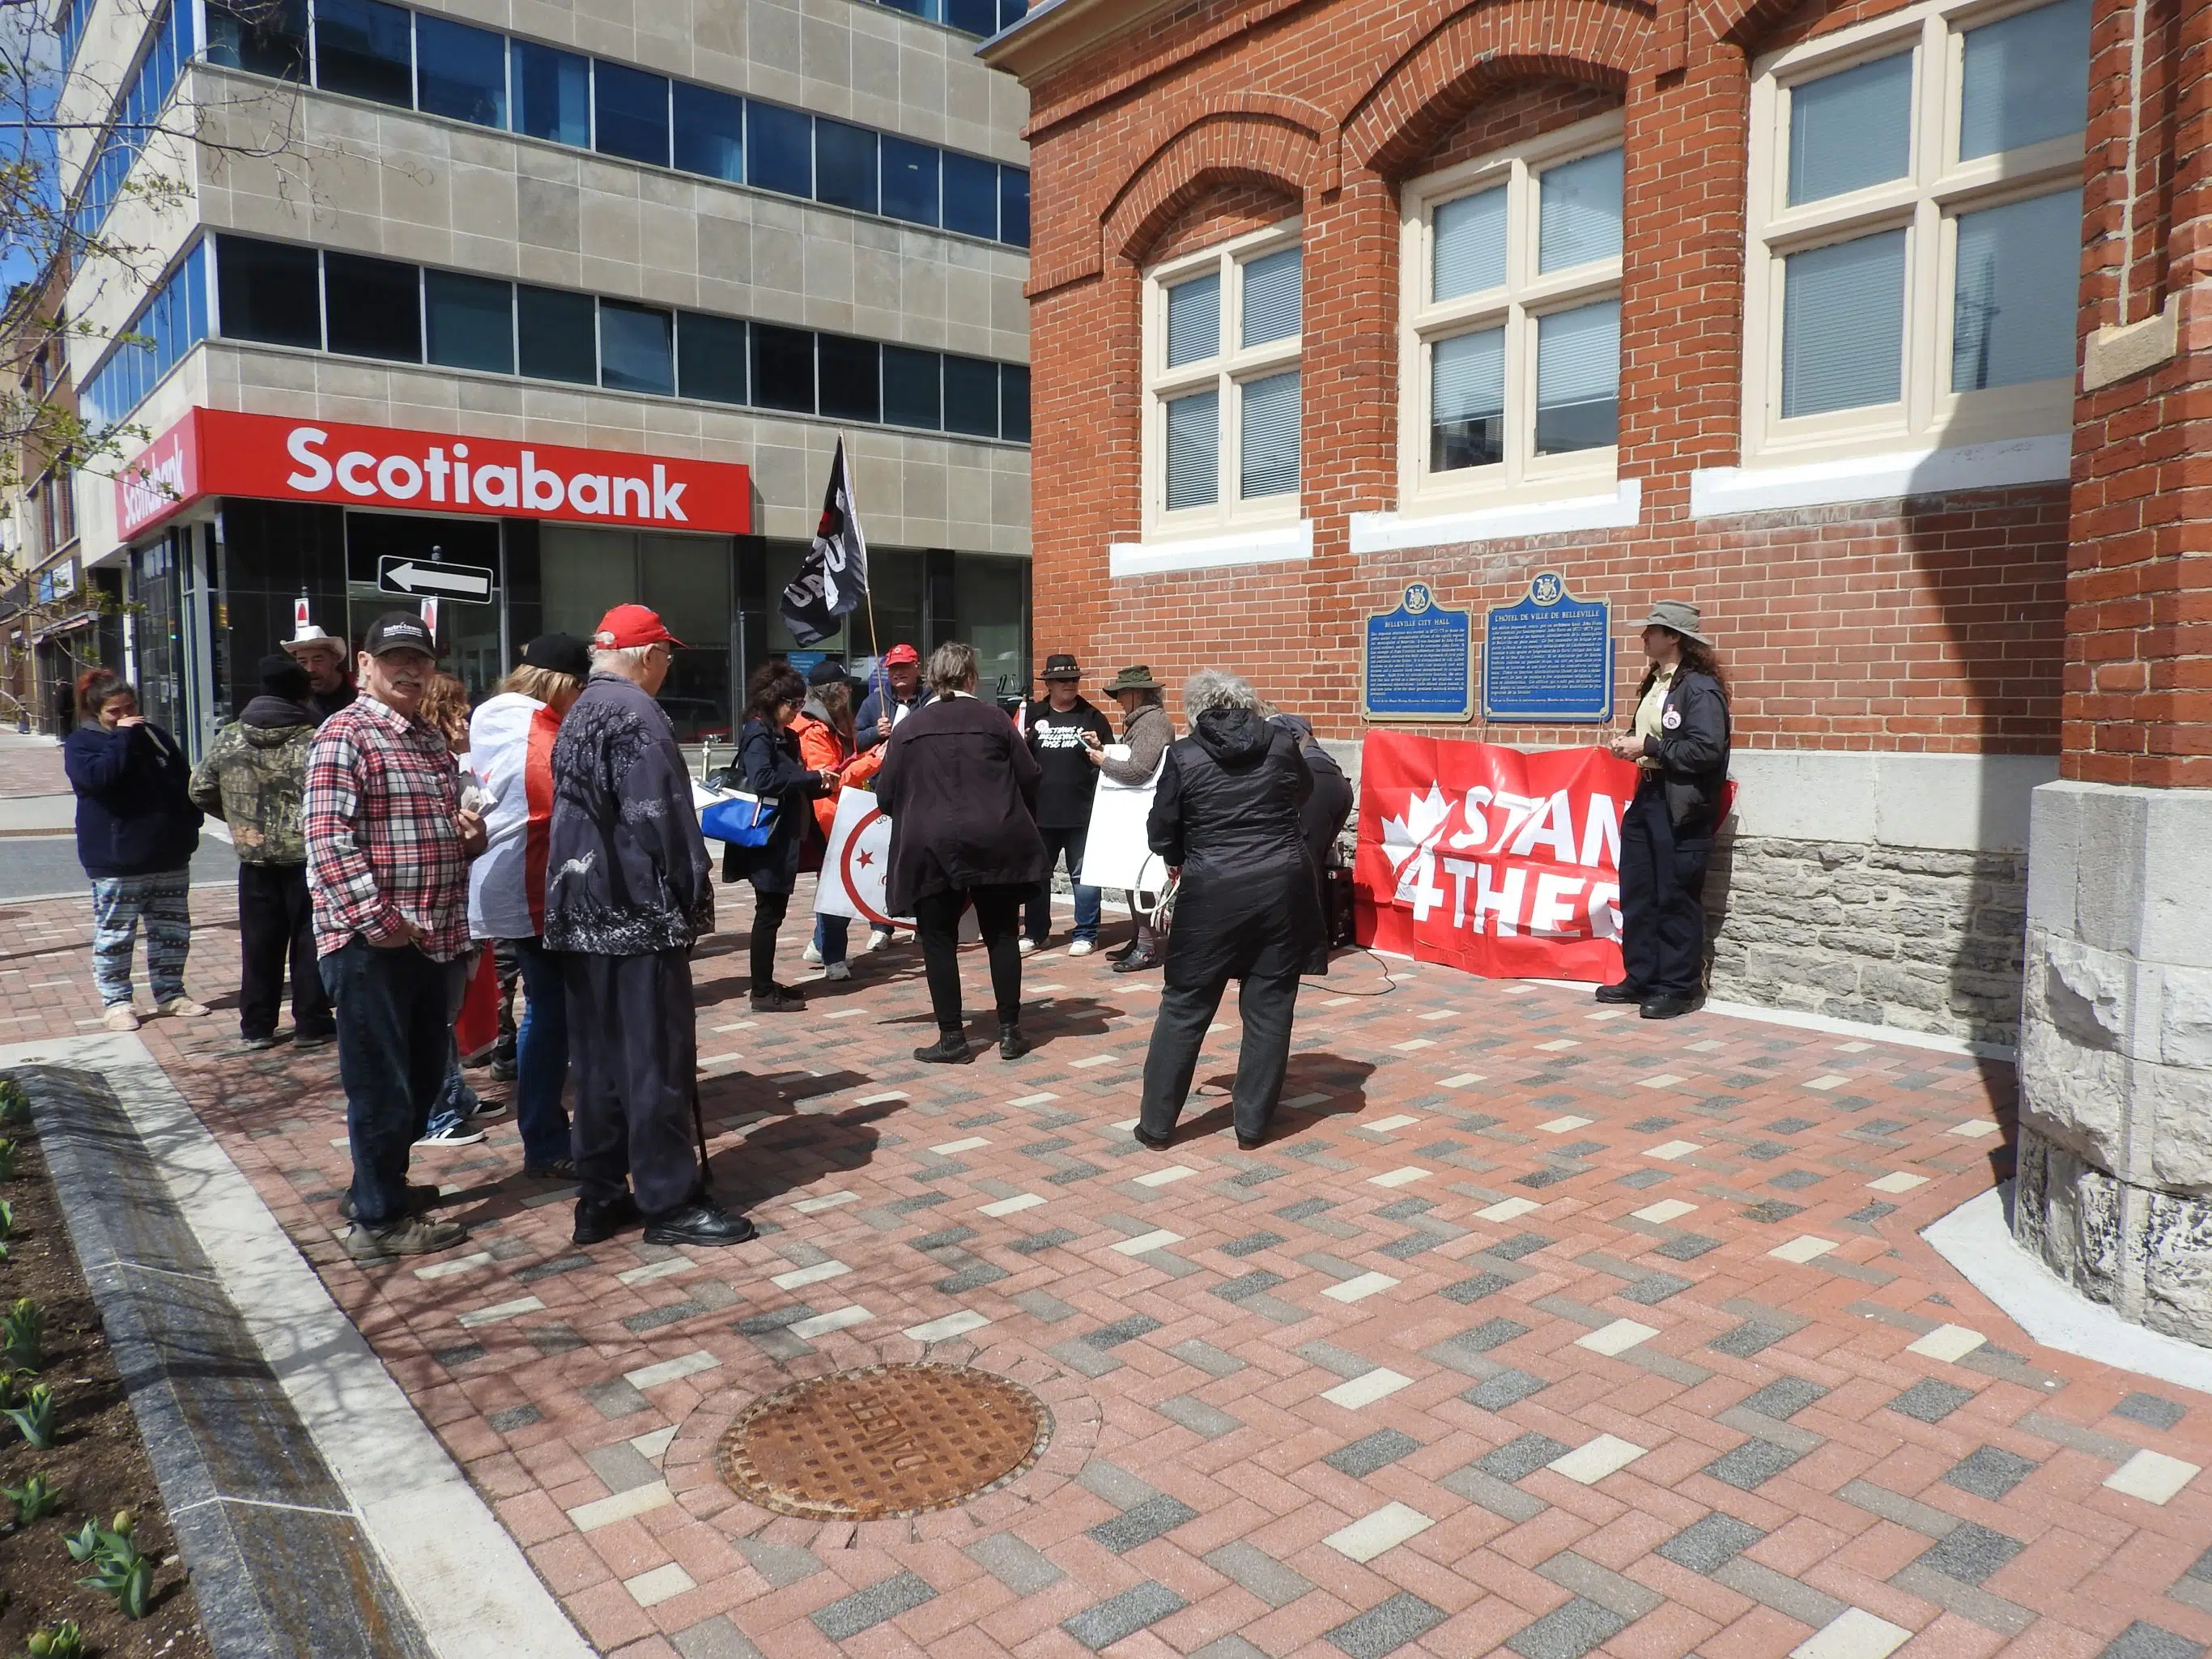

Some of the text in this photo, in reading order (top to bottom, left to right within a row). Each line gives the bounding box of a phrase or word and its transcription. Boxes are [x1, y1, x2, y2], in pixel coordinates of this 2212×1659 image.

[286, 427, 688, 521] Scotiabank
[1531, 612, 1549, 620] VILLE
[1562, 610, 1600, 619] BELLEVILLE
[1385, 620, 1415, 628] BELLEVILLE
